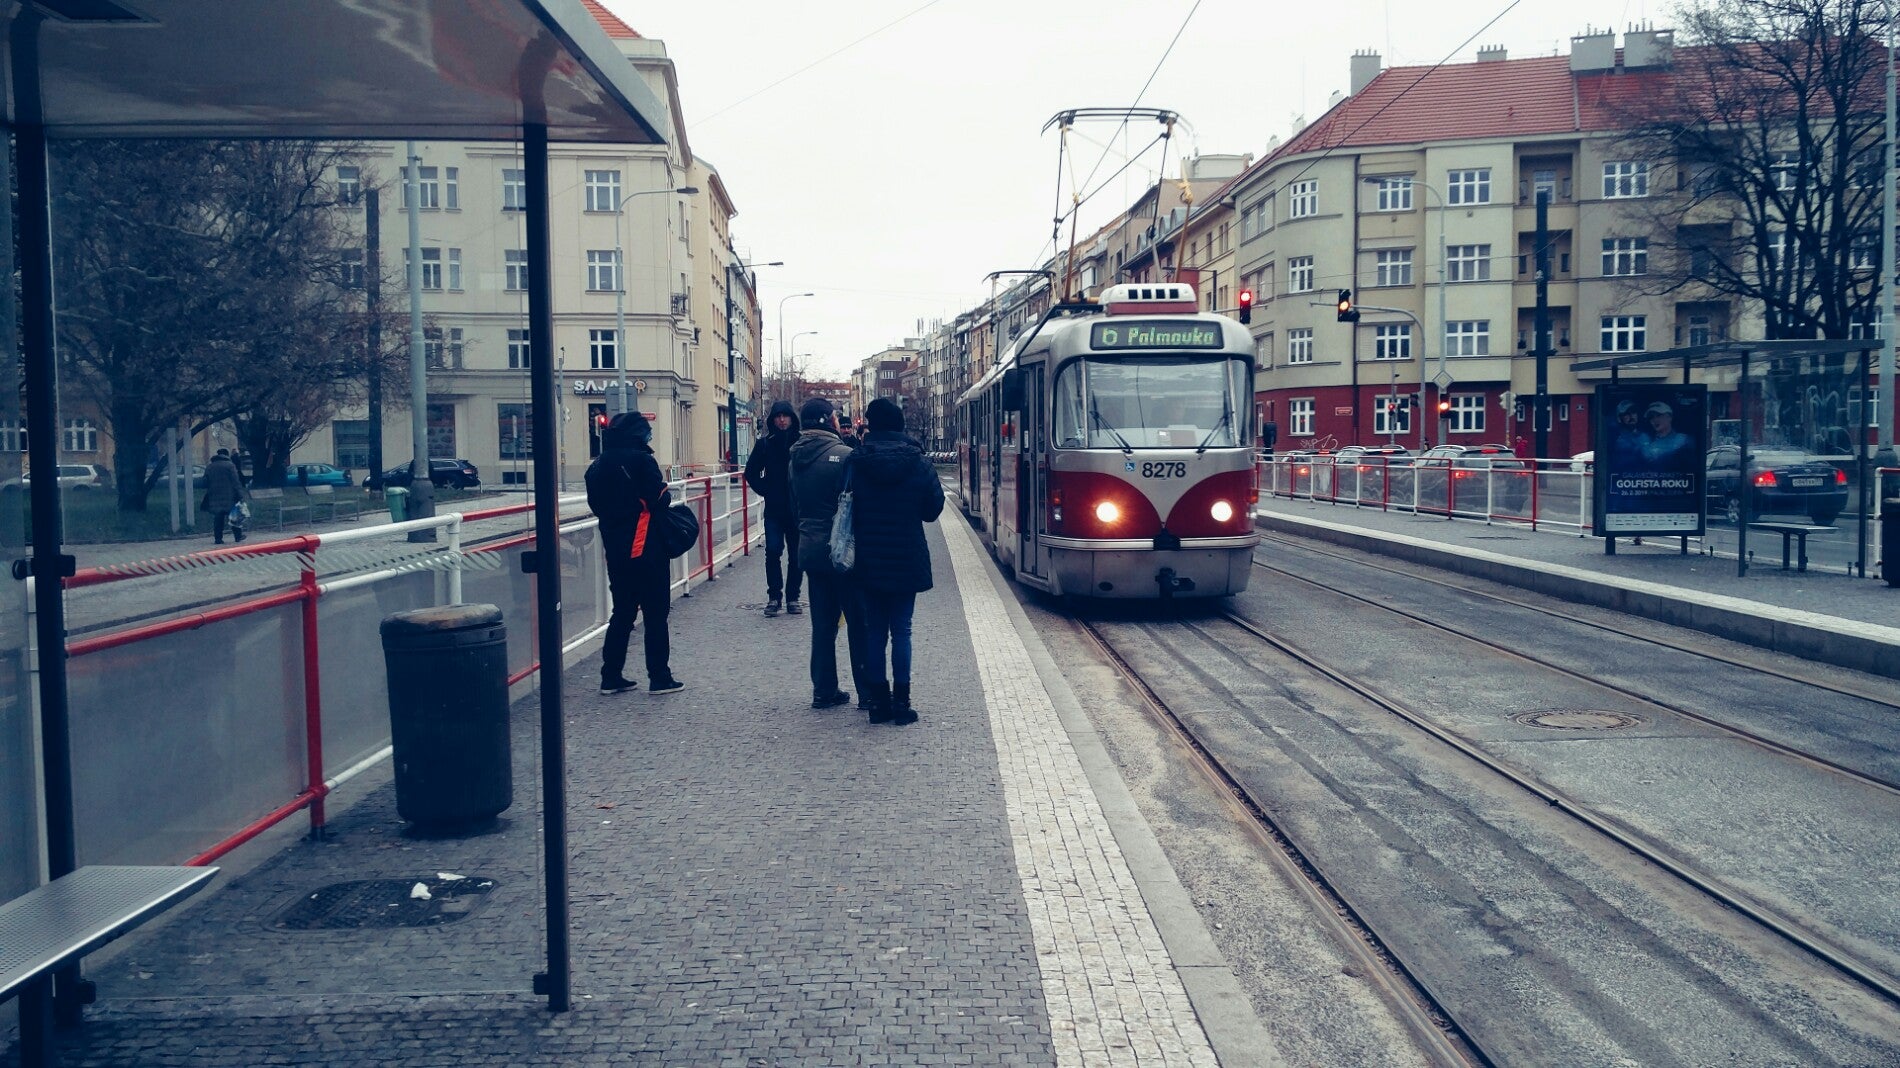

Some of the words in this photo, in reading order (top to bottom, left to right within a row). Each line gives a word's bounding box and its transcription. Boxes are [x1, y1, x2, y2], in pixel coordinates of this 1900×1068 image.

[1102, 327, 1118, 346] 6
[1127, 326, 1215, 346] Palmovka
[1142, 462, 1187, 479] 8278
[1616, 479, 1660, 489] GOLFISTA
[1661, 479, 1689, 489] ROKU
